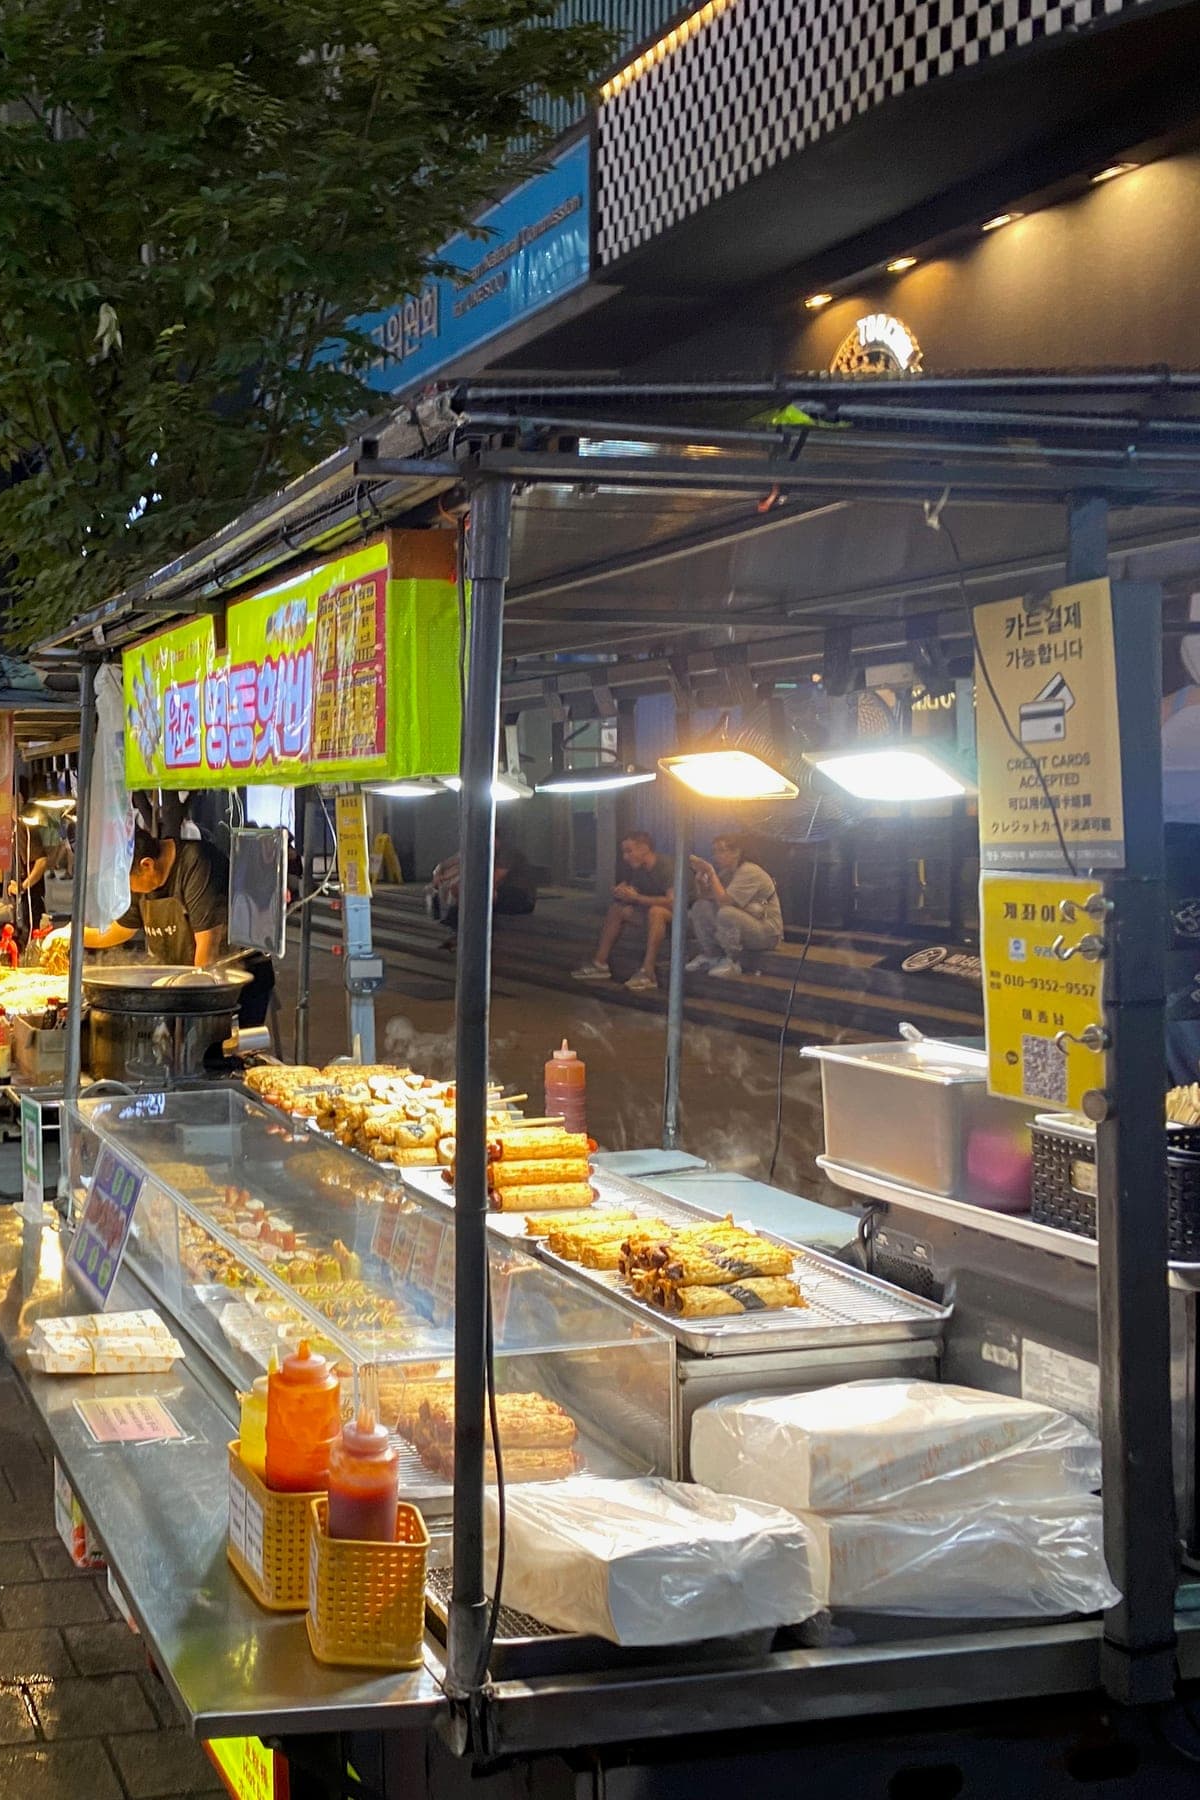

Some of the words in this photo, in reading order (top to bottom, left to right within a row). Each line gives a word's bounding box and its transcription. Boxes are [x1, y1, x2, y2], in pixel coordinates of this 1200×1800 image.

[1005, 601, 1082, 641] 카드결제
[1005, 637, 1084, 669] 가능합니다
[1051, 752, 1091, 768] CARDS
[1020, 772, 1080, 789] ACCEPTED
